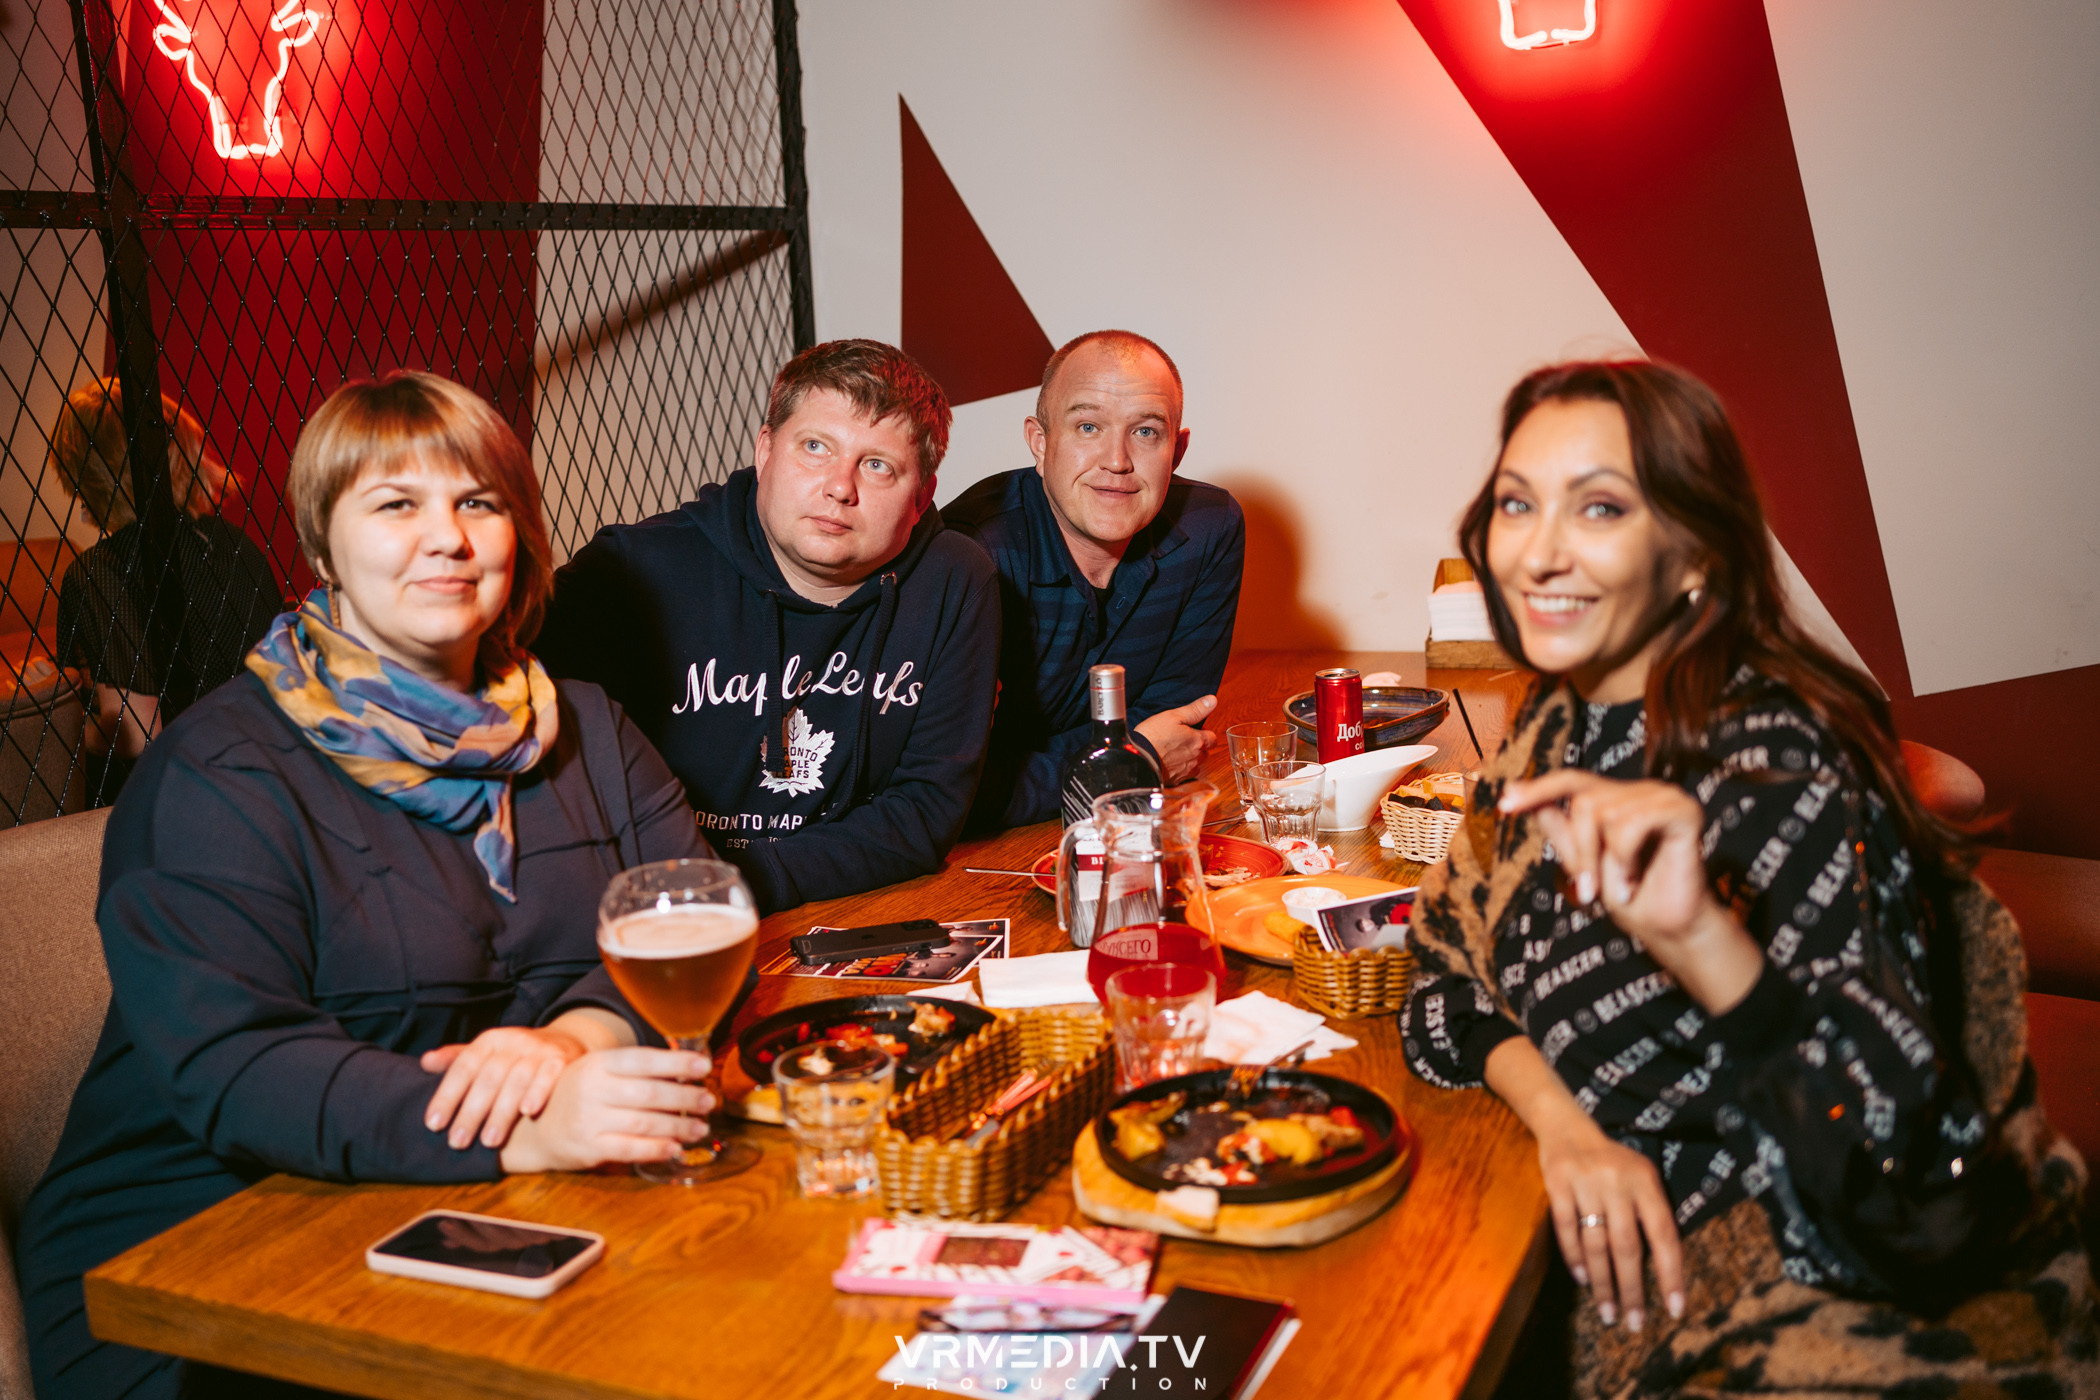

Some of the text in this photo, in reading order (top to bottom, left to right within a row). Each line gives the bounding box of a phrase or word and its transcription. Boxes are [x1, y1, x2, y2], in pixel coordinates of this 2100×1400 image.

[1336, 720, 1364, 743] Доб
[784, 746, 818, 762] RONTO
[784, 759, 810, 769] APLE
[695, 810, 807, 831] ORONTO MAP
